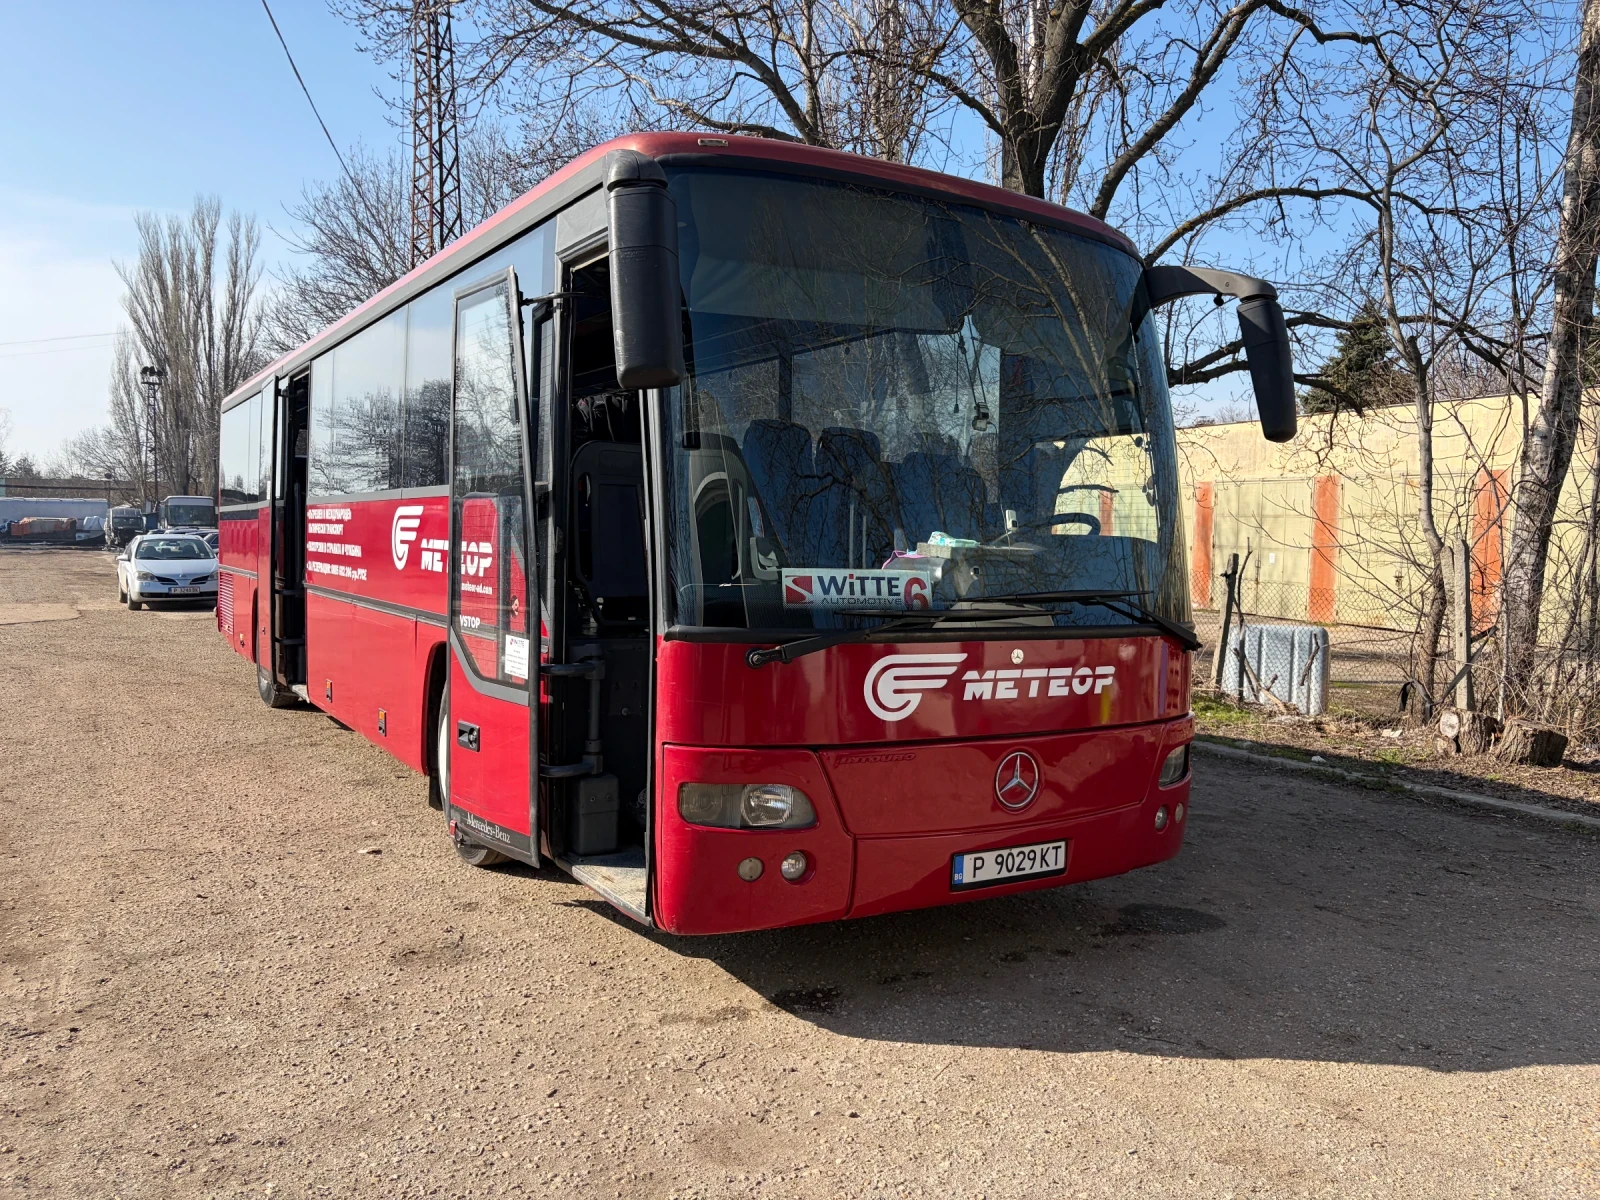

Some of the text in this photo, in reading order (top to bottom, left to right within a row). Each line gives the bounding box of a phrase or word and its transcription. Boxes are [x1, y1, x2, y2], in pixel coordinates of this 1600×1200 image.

[821, 597, 902, 605] AUTOMOTIVE
[903, 577, 929, 611] 6
[466, 811, 511, 844] Mercedes-Benz
[954, 873, 963, 881] BG
[972, 856, 985, 879] P
